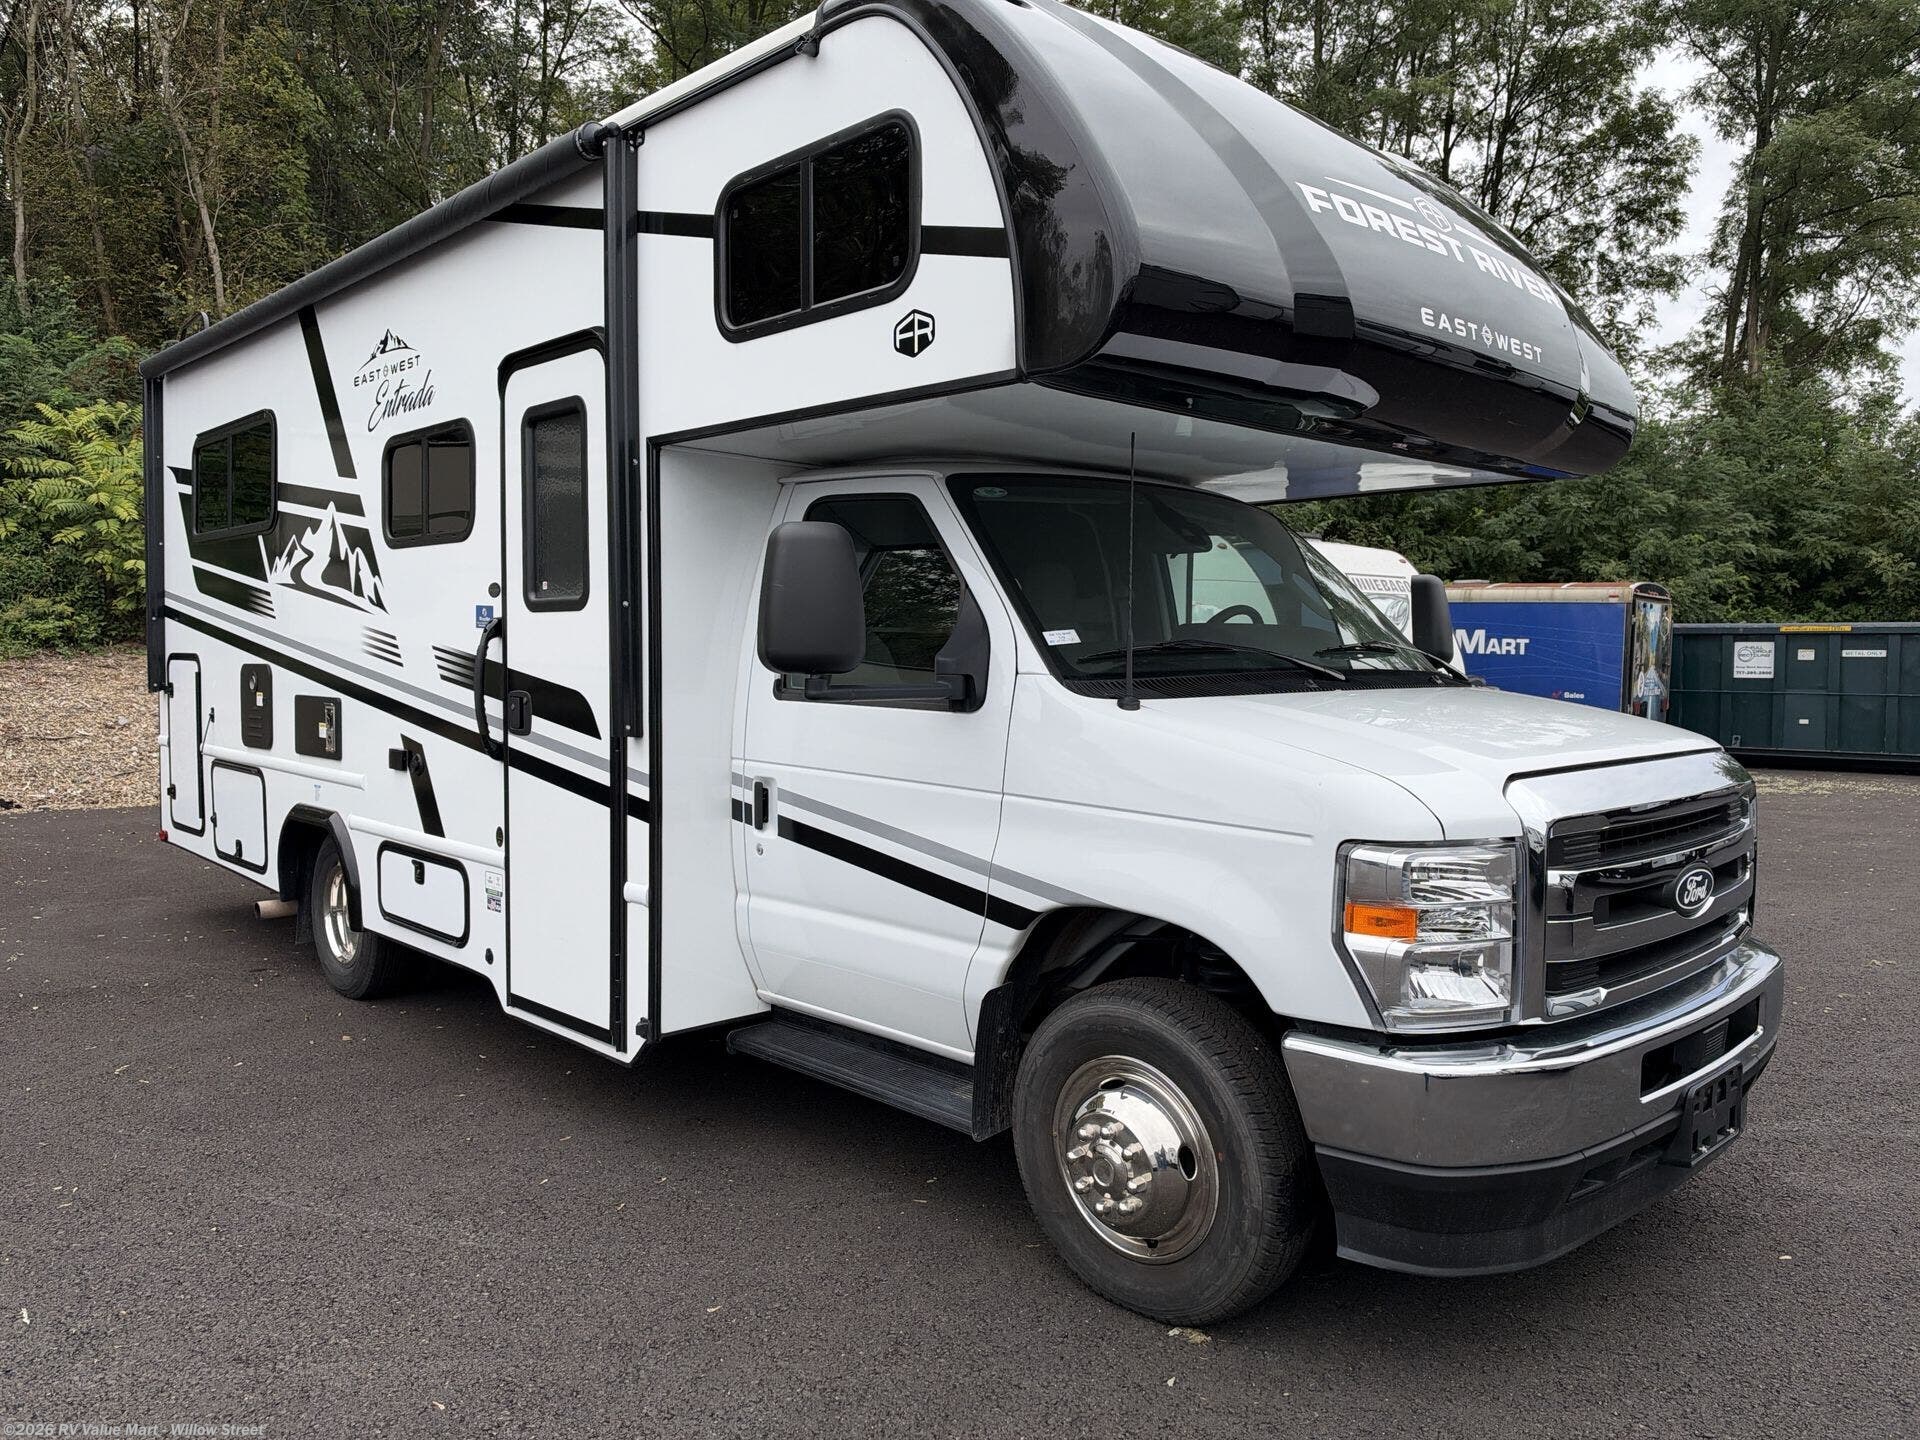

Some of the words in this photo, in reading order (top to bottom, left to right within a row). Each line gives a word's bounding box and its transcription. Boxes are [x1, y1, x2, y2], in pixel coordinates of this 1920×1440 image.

[1295, 181, 1465, 263] FOREST
[1468, 245, 1565, 311] RIVER
[1421, 306, 1478, 341] EAST
[1496, 333, 1543, 363] WEST
[353, 368, 382, 387] EAST
[390, 354, 421, 375] WEST
[367, 369, 435, 432] Entrada
[1683, 875, 1708, 904] Ford
